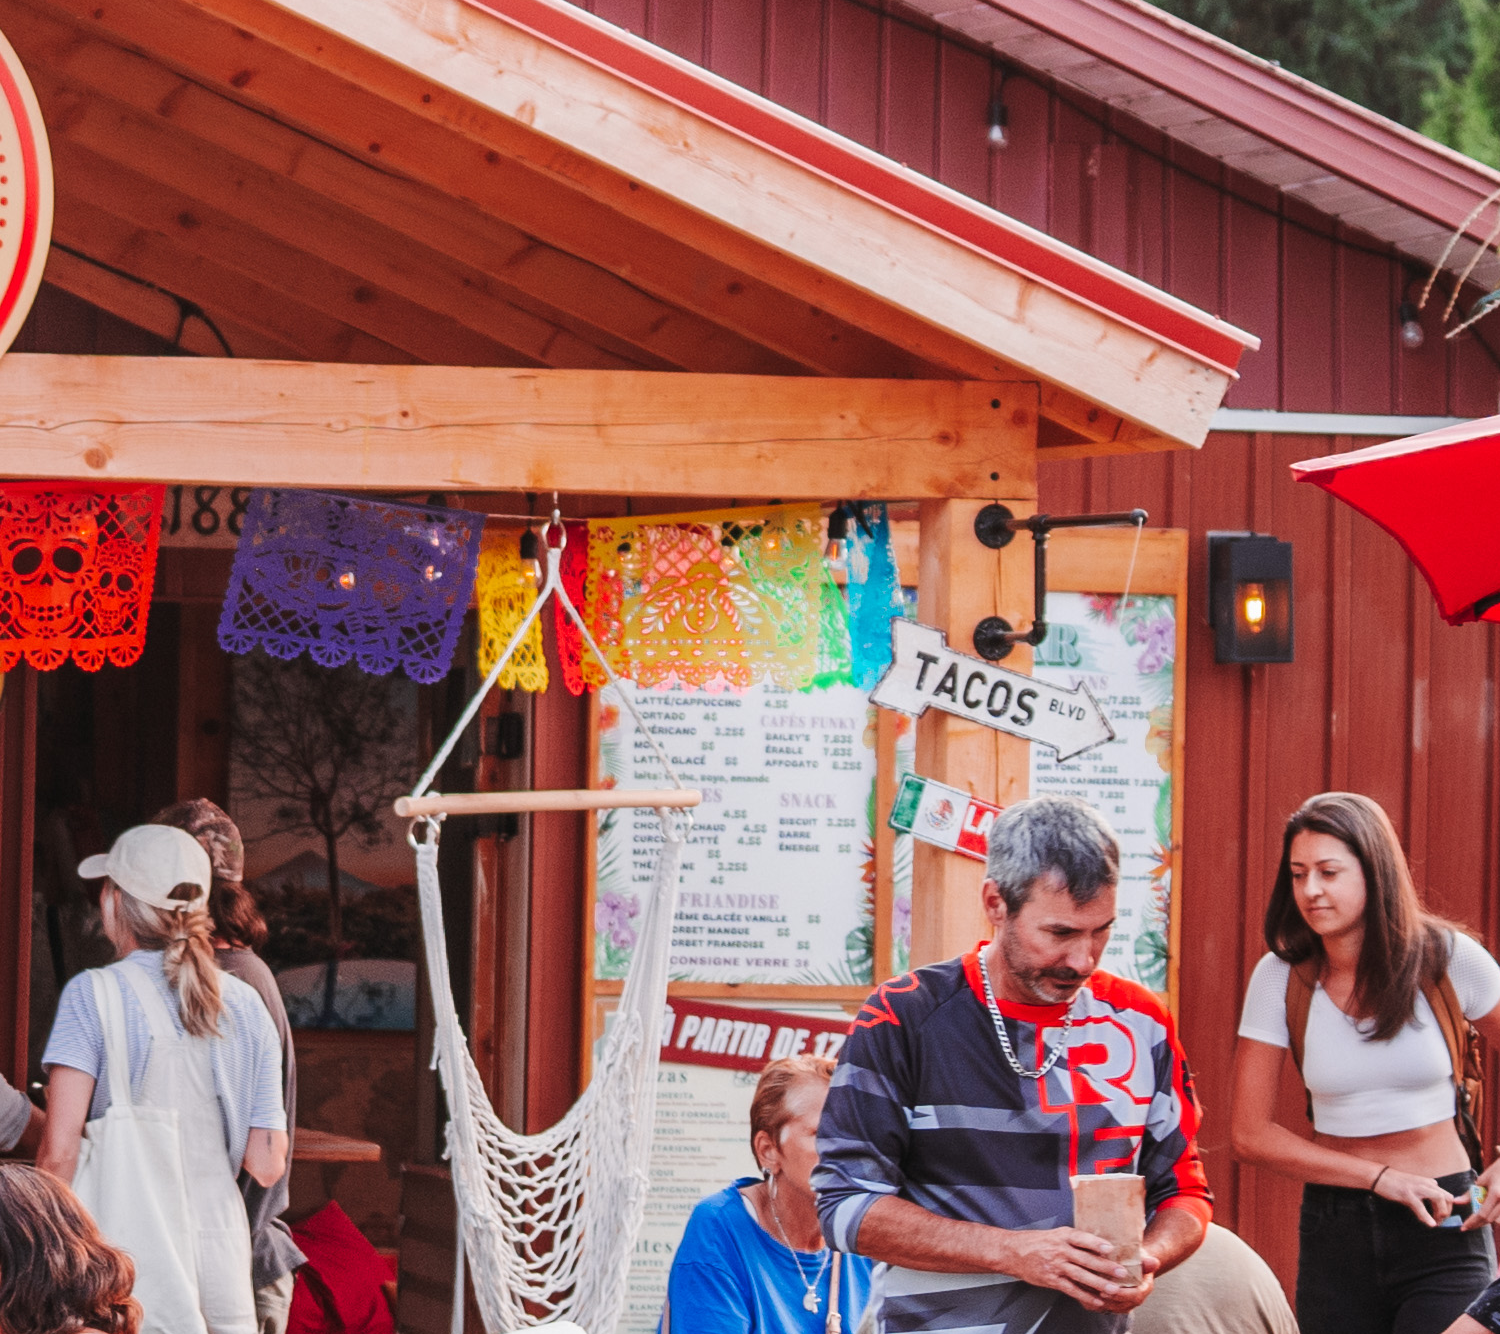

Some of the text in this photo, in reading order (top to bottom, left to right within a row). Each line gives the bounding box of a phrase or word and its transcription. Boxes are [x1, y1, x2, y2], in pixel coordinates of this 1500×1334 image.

[914, 650, 1086, 727] TACOS BLVD
[760, 713, 859, 730] CAFÉS FUNKY
[634, 740, 665, 751] MOA
[634, 754, 670, 765] LATT
[779, 792, 837, 809] SNACK
[679, 892, 780, 909] FRIANDISE
[673, 912, 700, 923] RÈME
[672, 926, 704, 935] ORBET
[671, 939, 704, 948] ORBET
[670, 955, 740, 967] CONSIGNE
[746, 957, 790, 968] VERRE
[676, 1014, 772, 1060] PARTIR
[770, 1027, 808, 1061] DE
